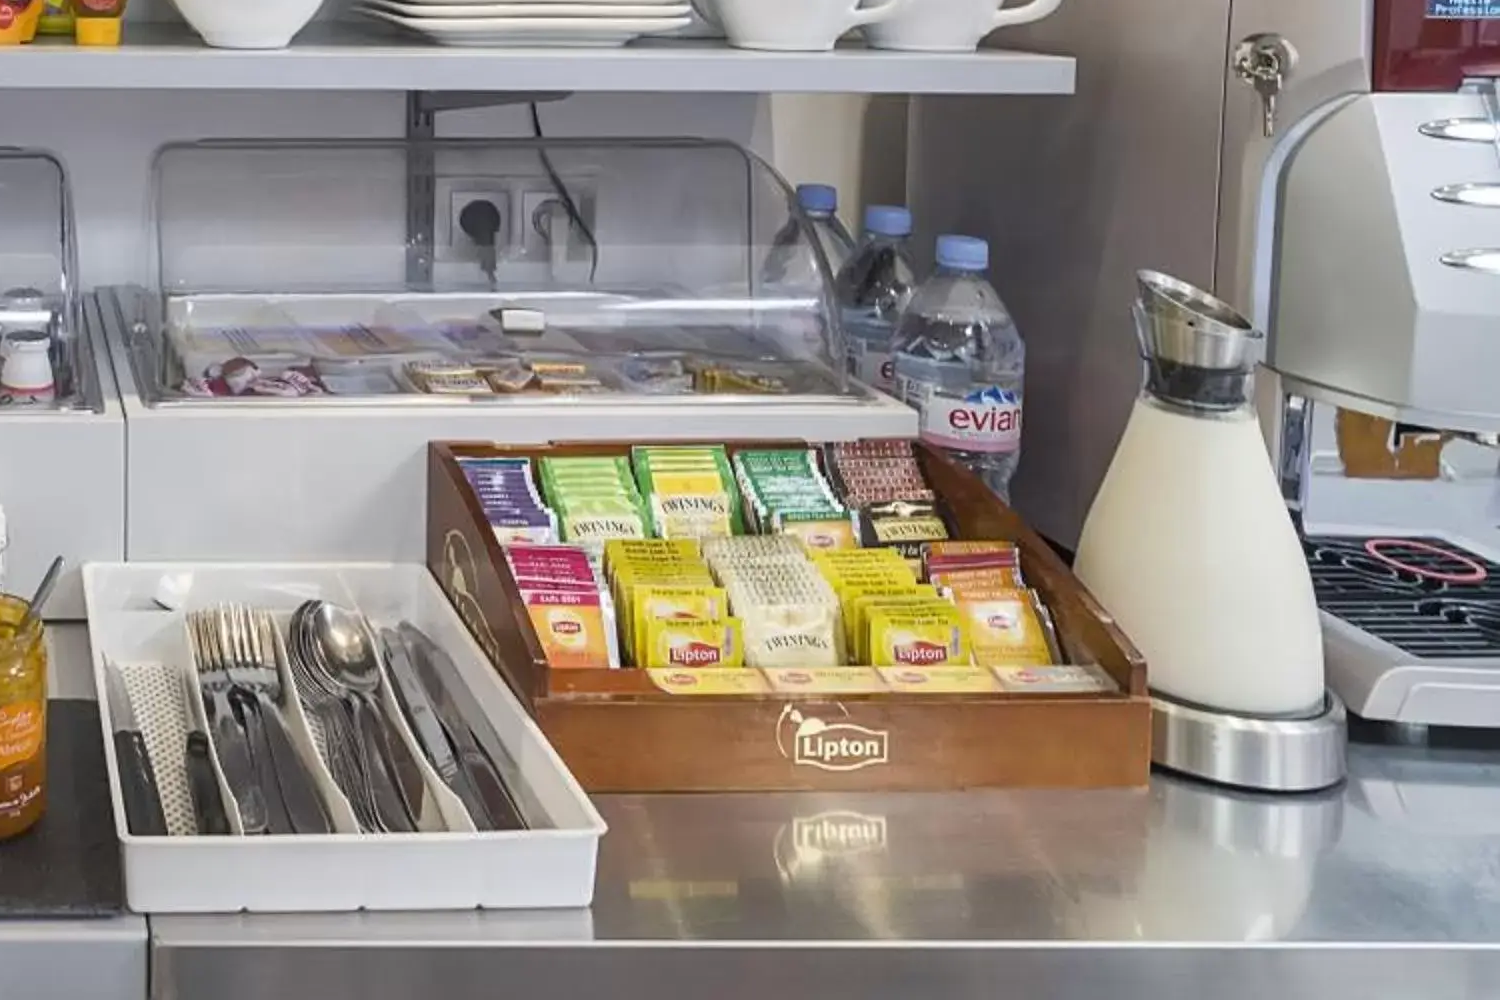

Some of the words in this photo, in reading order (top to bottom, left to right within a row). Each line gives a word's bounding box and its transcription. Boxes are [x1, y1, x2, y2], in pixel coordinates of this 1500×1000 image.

[662, 497, 725, 514] TWININGS
[573, 520, 635, 536] TWININGS
[765, 633, 828, 652] TWININGS
[672, 648, 717, 664] Lipton
[899, 647, 945, 663] Lipton
[803, 736, 880, 761] Lipton
